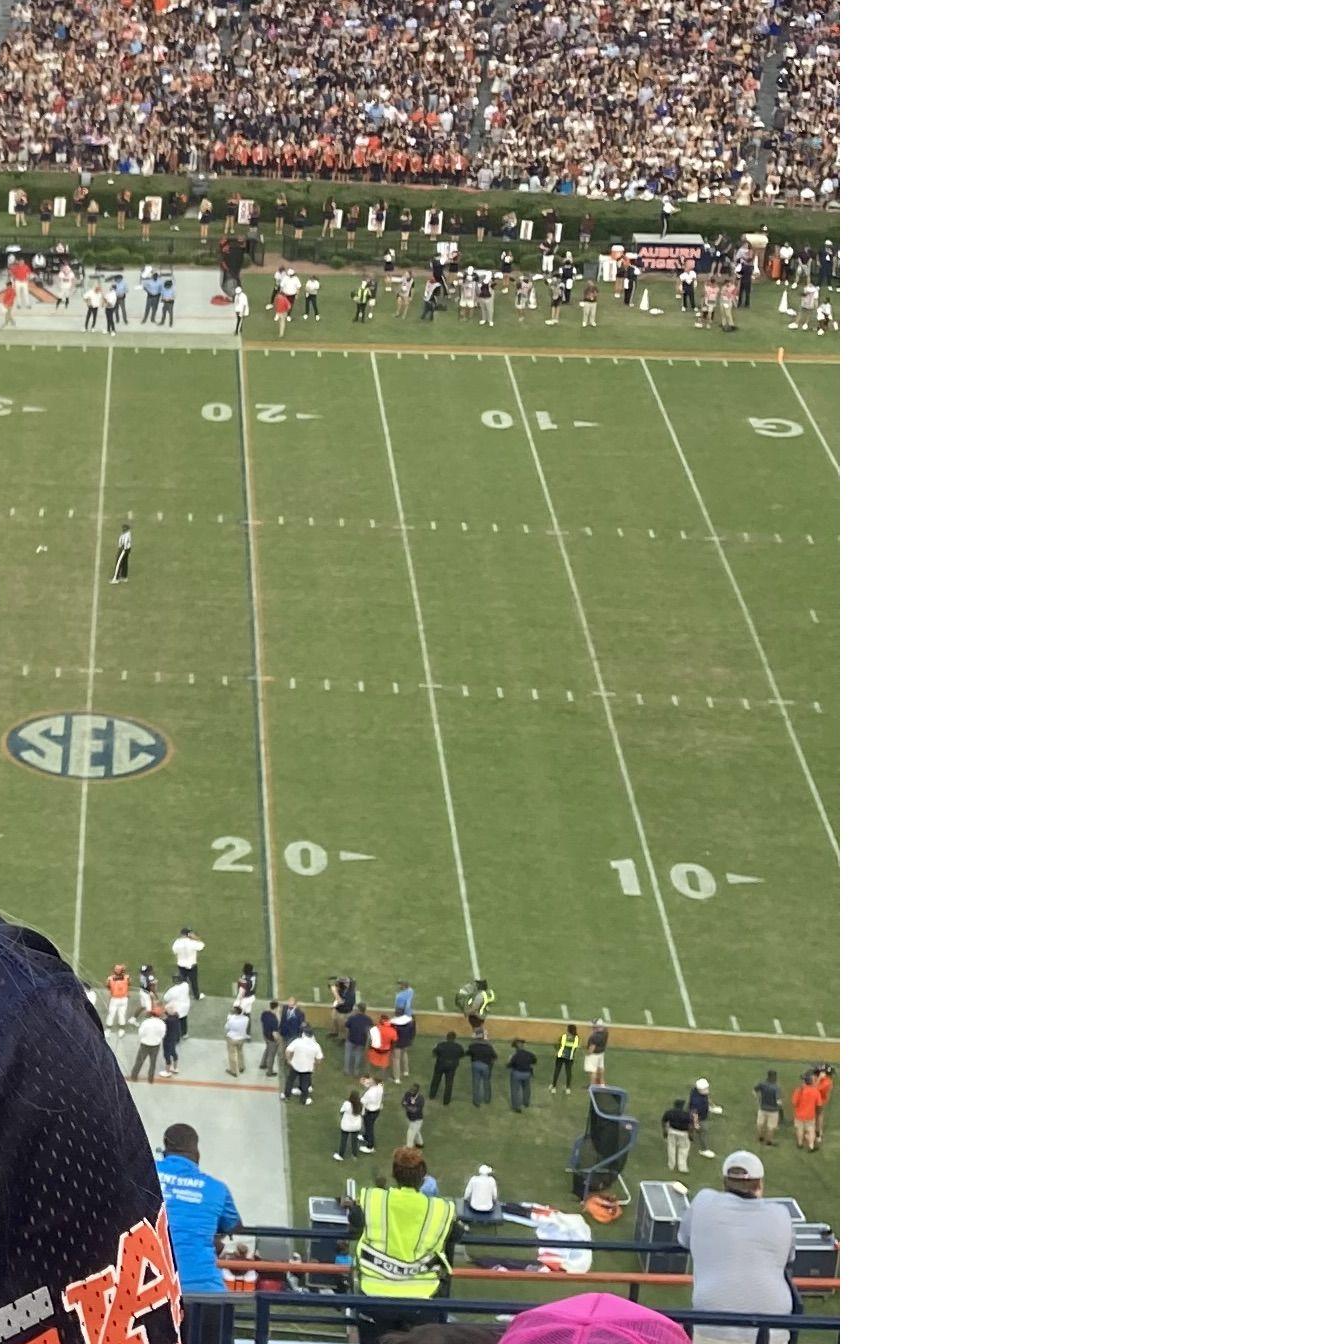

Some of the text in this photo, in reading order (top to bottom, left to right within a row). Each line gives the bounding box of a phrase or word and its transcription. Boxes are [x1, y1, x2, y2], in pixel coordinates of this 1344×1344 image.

[638, 246, 702, 259] AUBURN
[17, 713, 157, 778] SEC
[210, 836, 329, 877] 20
[610, 857, 717, 901] 10
